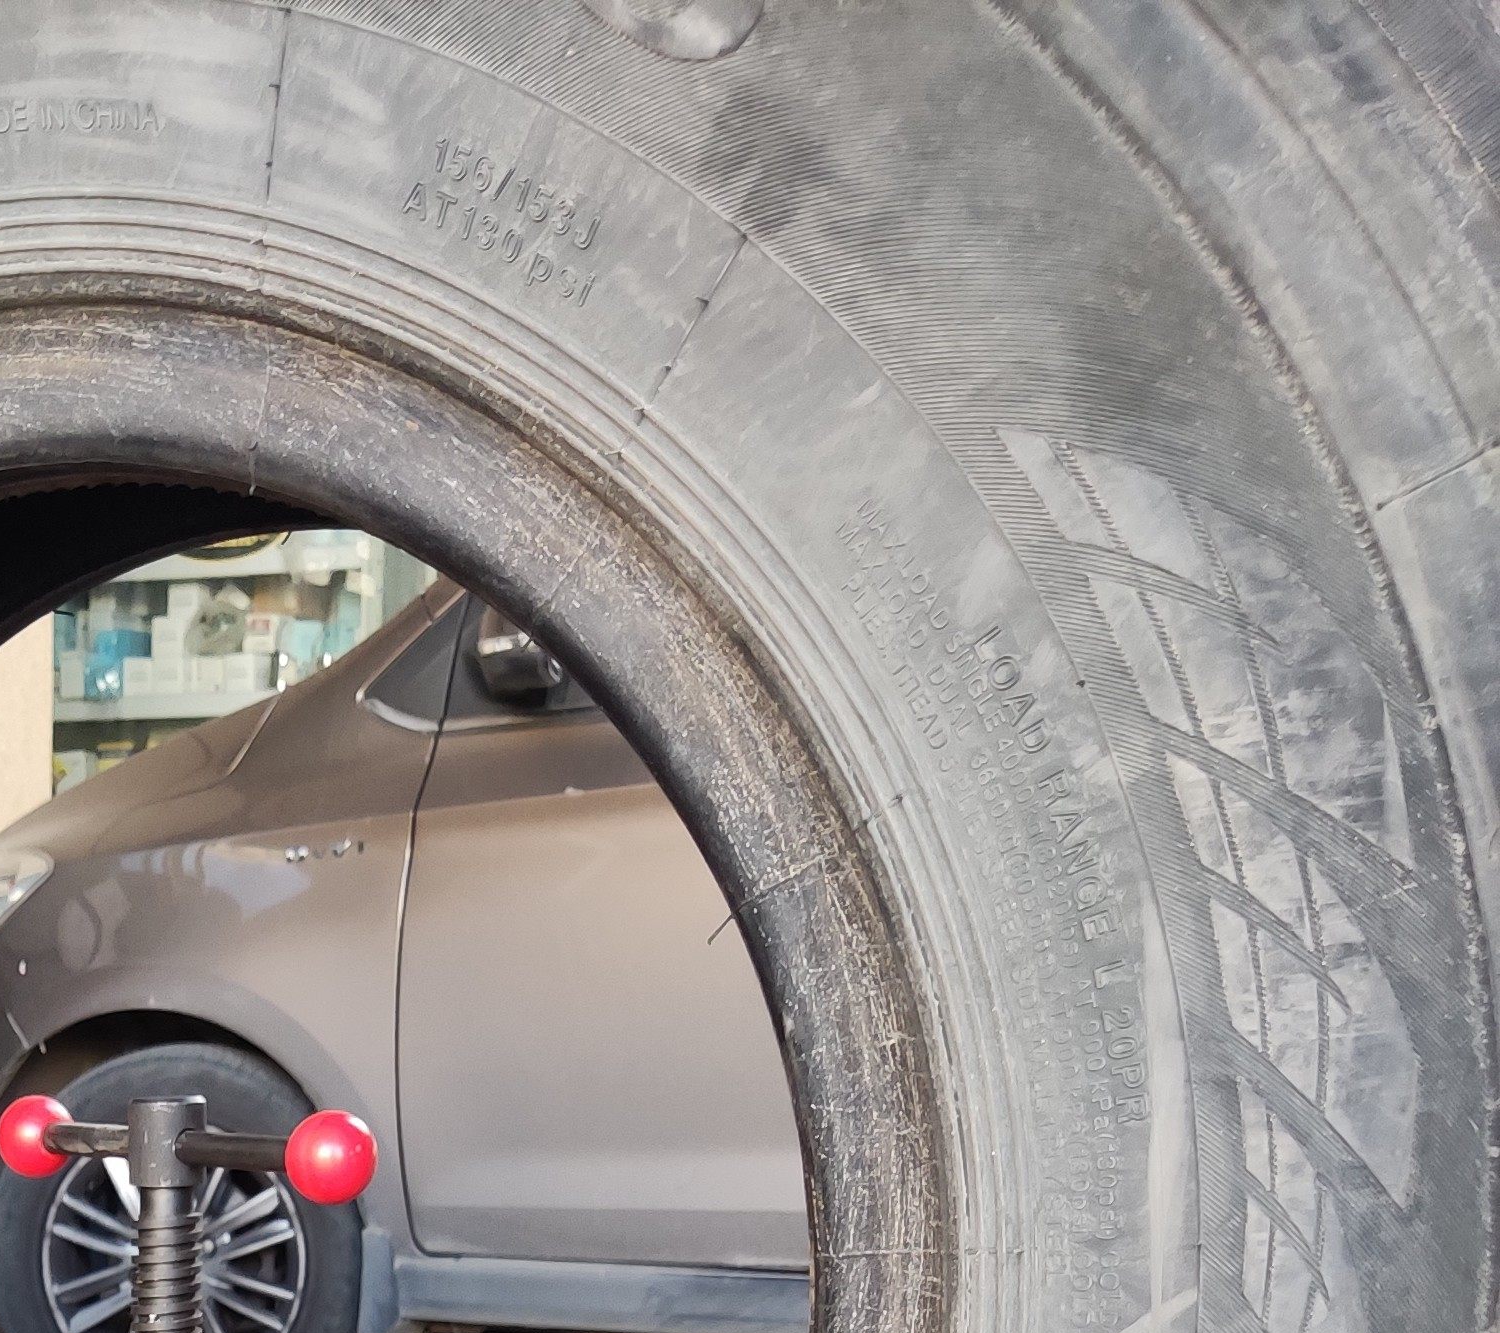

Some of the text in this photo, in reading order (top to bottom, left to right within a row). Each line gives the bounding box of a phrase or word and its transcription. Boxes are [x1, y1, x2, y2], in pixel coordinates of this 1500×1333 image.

[39, 102, 66, 130] IN
[75, 101, 163, 133] CHINA
[970, 628, 1152, 1124] LOAD RANGE L 20PR
